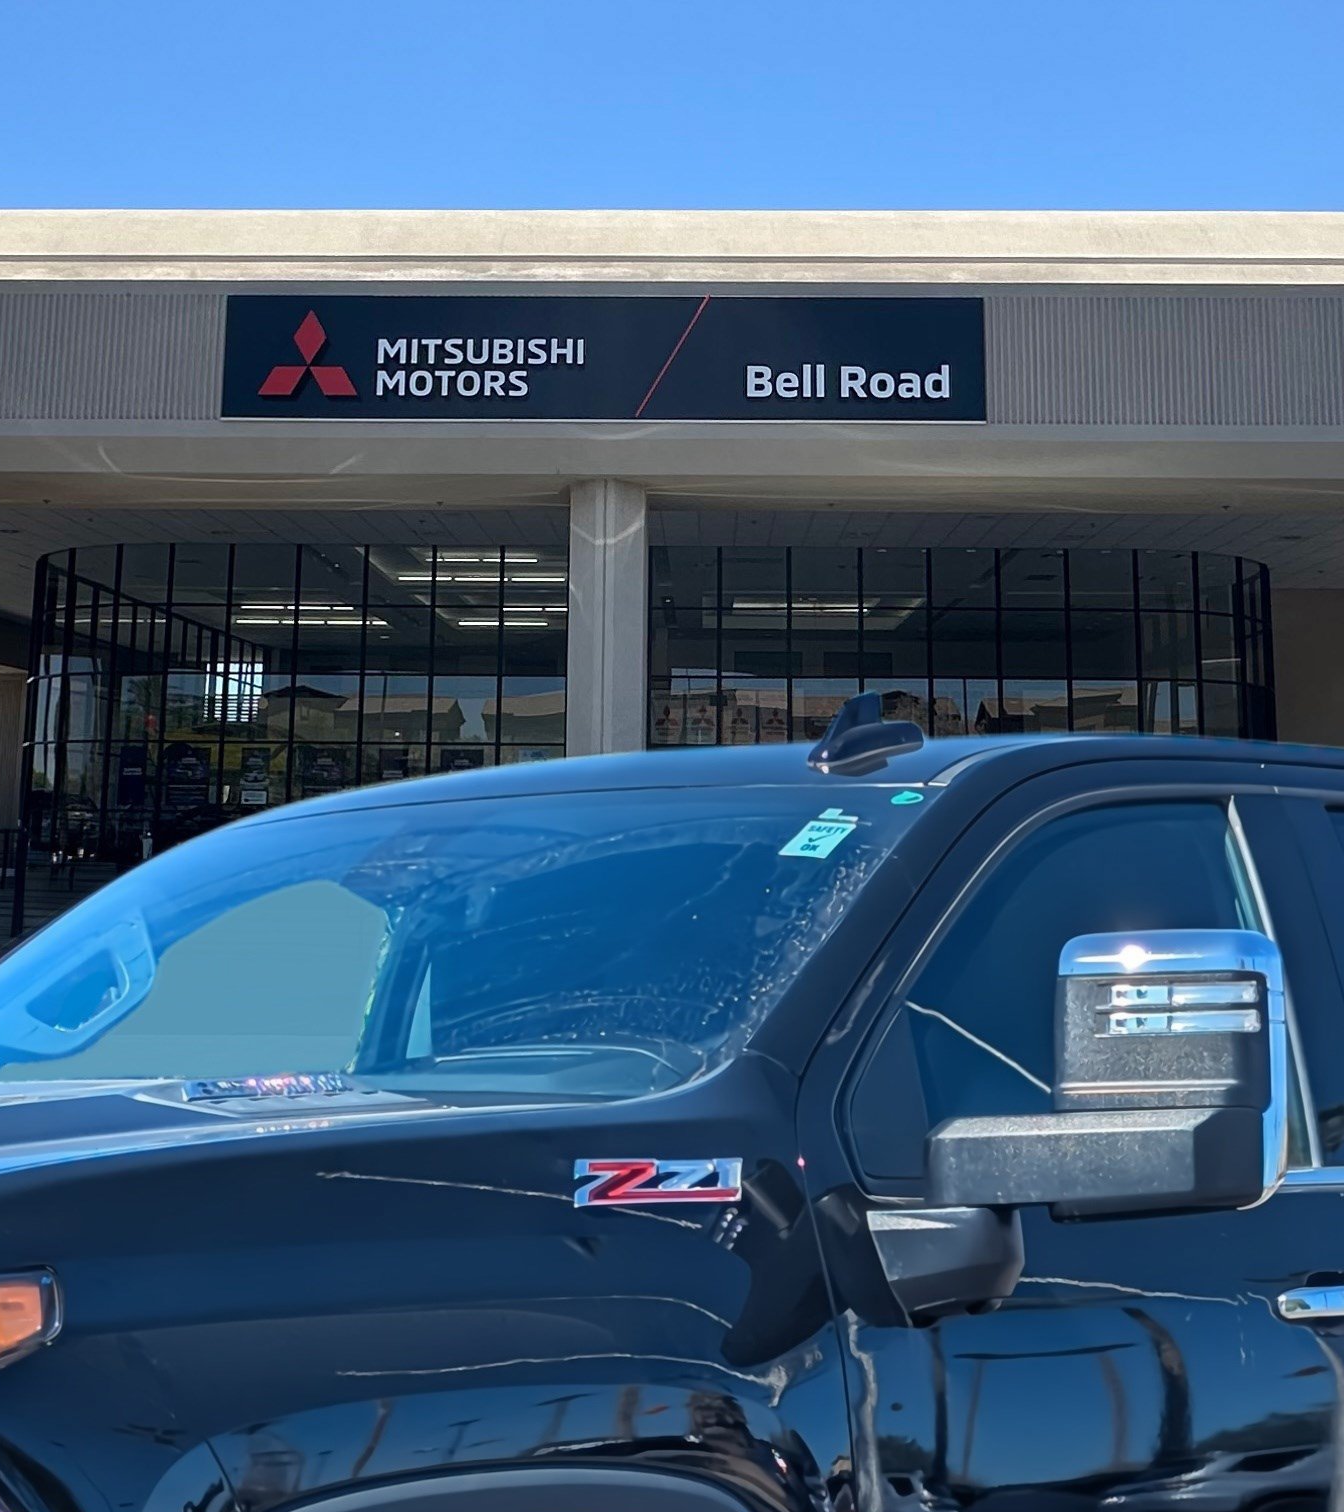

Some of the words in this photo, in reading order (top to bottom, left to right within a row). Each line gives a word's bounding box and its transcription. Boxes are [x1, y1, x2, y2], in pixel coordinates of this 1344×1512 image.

[376, 338, 584, 365] MITSUBISHI
[376, 370, 529, 397] MOTORS
[746, 364, 825, 398] Bell
[840, 364, 951, 399] Road
[807, 825, 847, 834] SAFETY
[800, 843, 820, 852] OK
